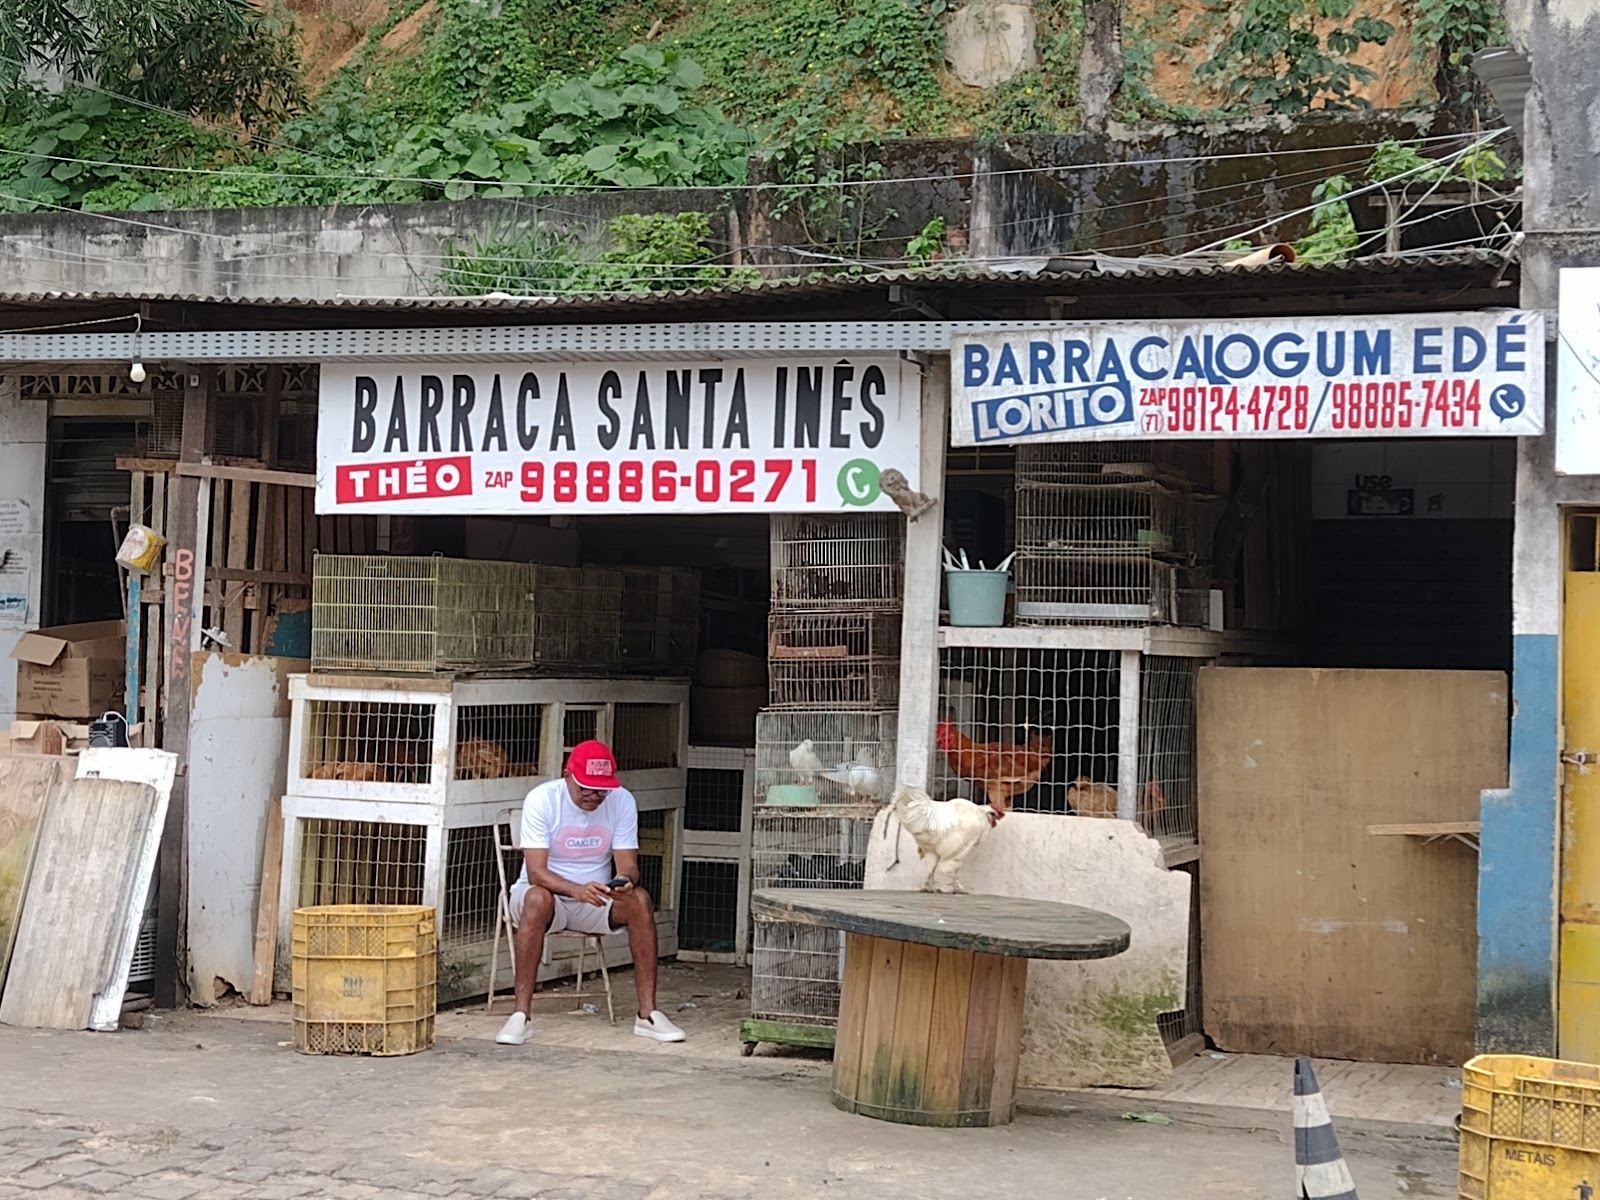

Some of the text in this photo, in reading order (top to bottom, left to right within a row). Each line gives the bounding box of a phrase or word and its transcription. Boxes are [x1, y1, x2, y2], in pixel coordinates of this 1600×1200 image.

[1413, 315, 1527, 374] EDÉ
[352, 358, 886, 453] BARRACA SANTA INÊS
[977, 386, 1126, 435] LORITO
[1140, 388, 1166, 406] ZAP
[349, 460, 461, 498] THÉO
[485, 459, 817, 503] ZAP 98886-0271
[566, 837, 600, 848] OAKLEY
[1505, 1147, 1556, 1167] METAIS
